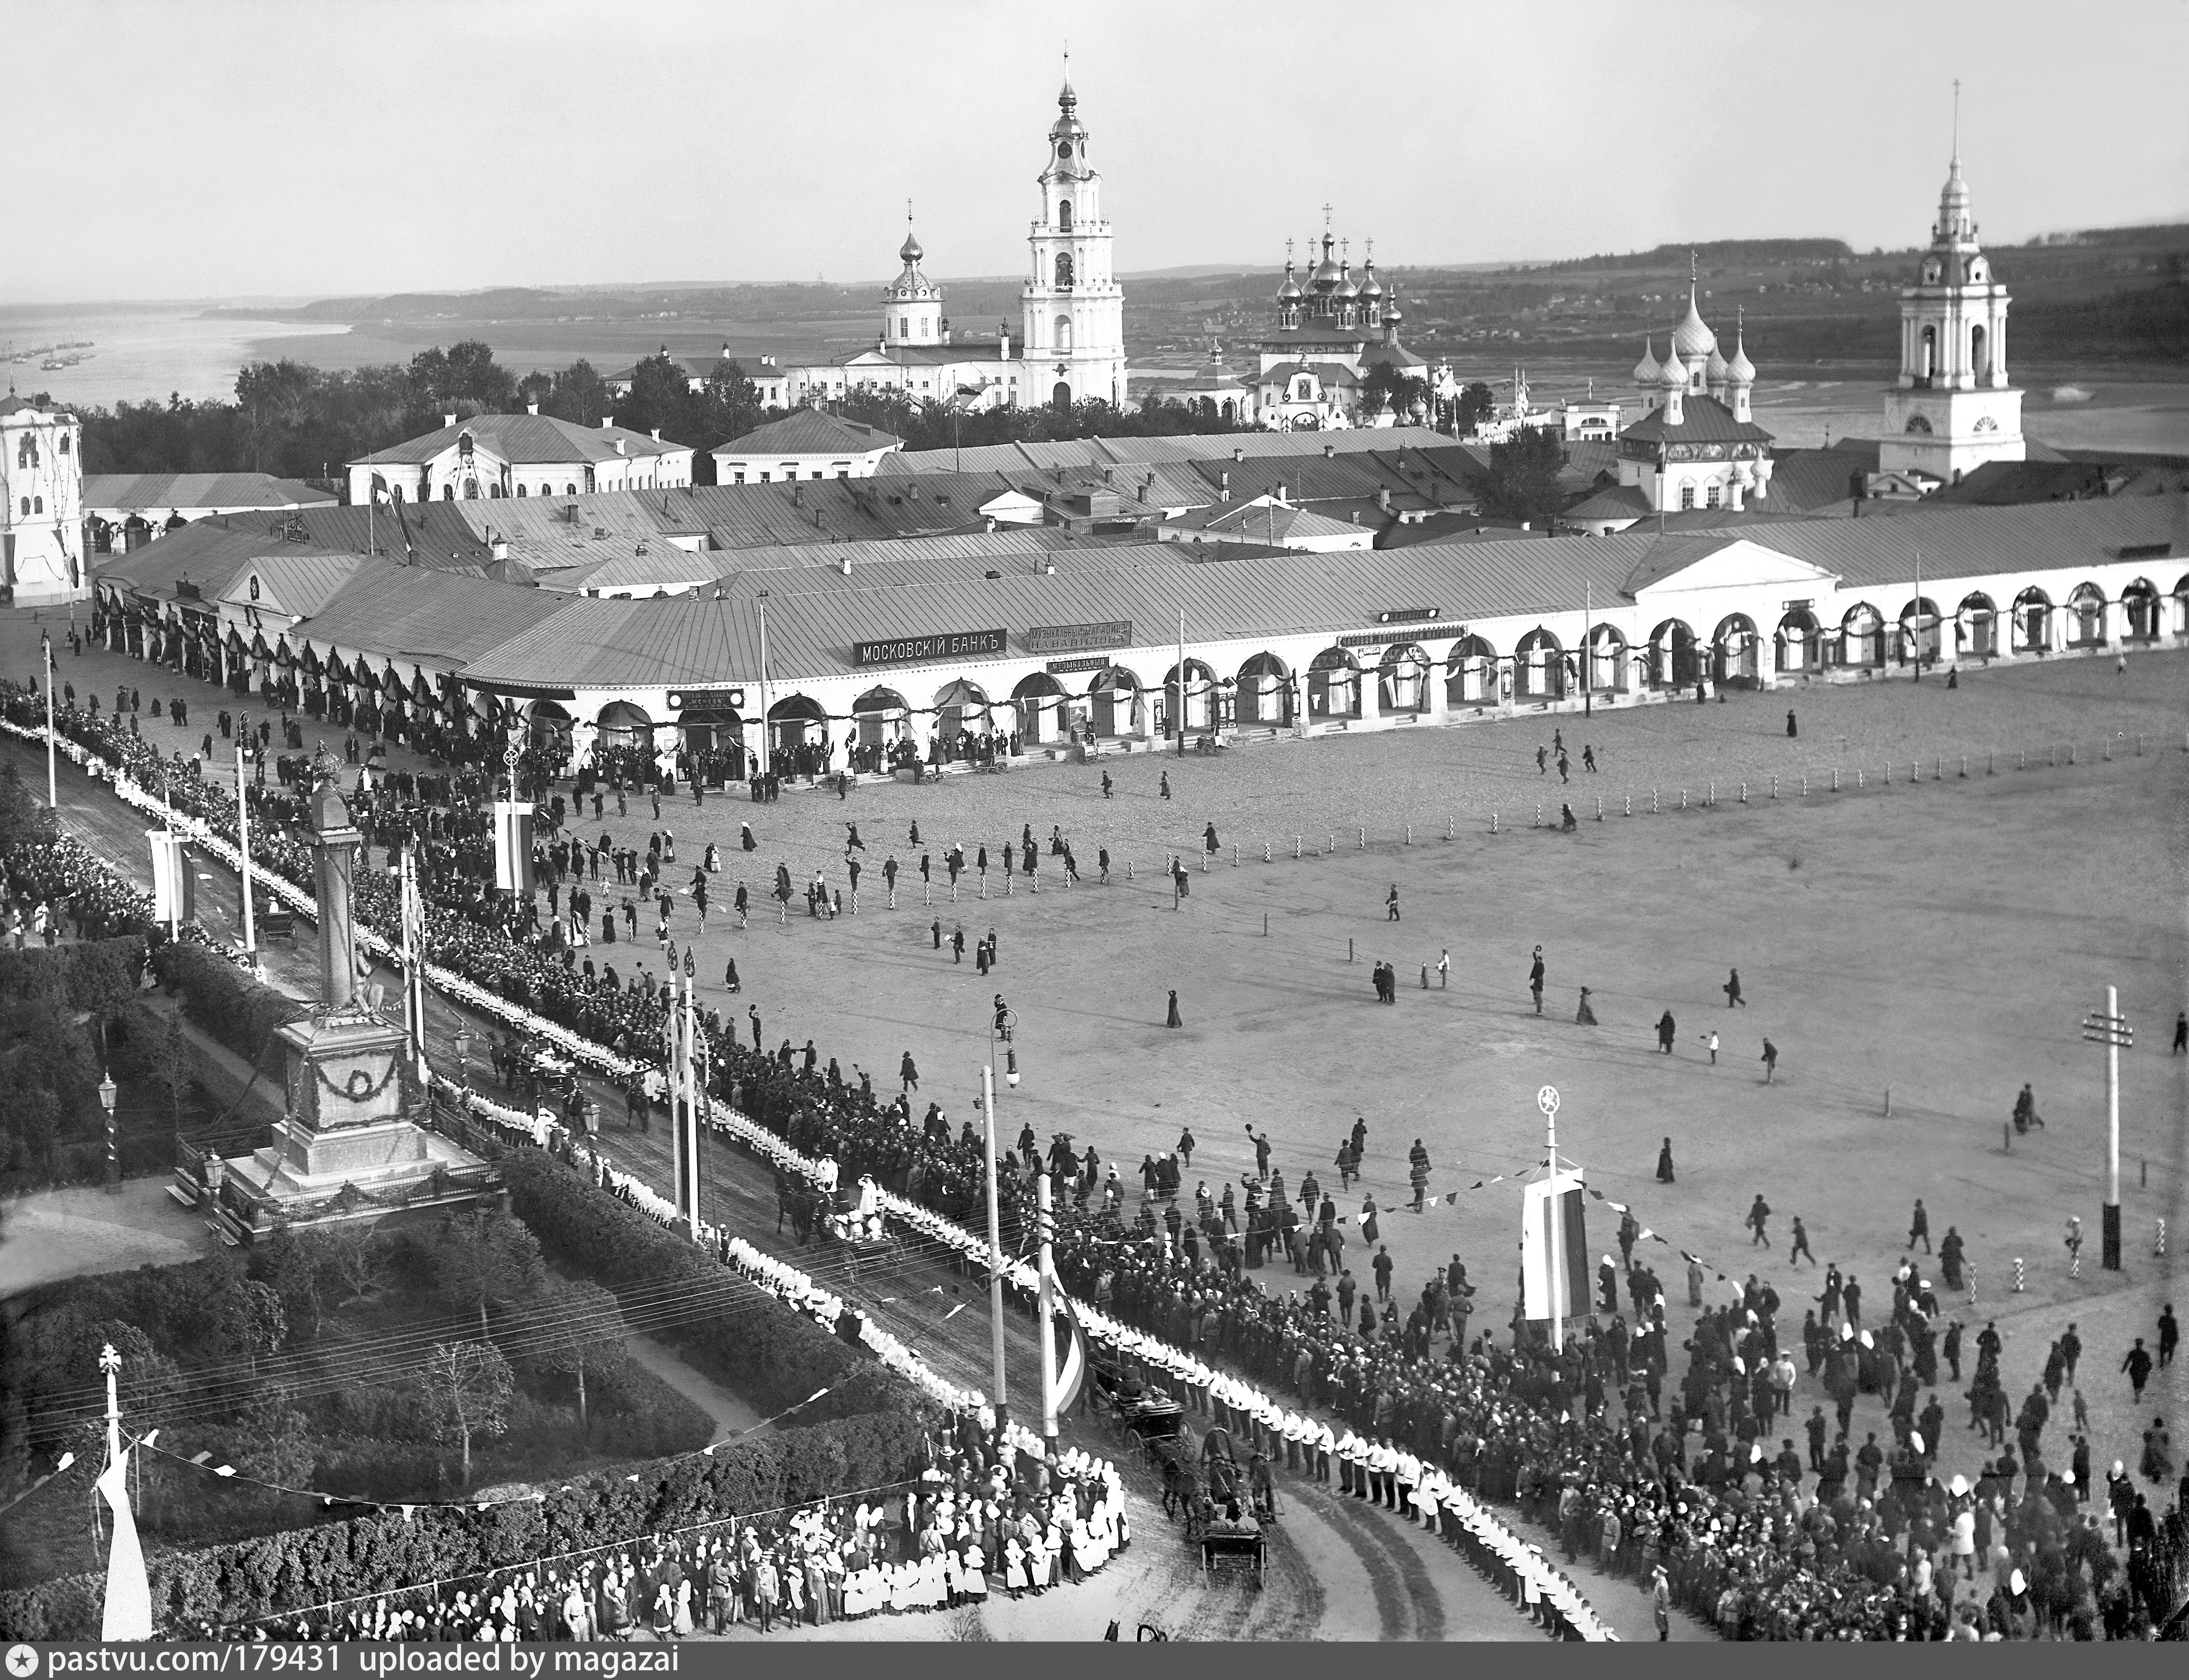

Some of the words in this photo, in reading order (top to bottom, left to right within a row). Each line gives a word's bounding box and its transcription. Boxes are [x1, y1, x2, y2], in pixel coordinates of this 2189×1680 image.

[1031, 626, 1083, 639] МУЗЫКАЛЬНЫЙ
[1085, 624, 1127, 636] МАГАЗИНЪ
[862, 637, 945, 662] МОСКОВСКІЙ
[952, 634, 998, 653] БАНКЪ
[1052, 658, 1105, 669] МУЗЫКАЛЬНЫЙ
